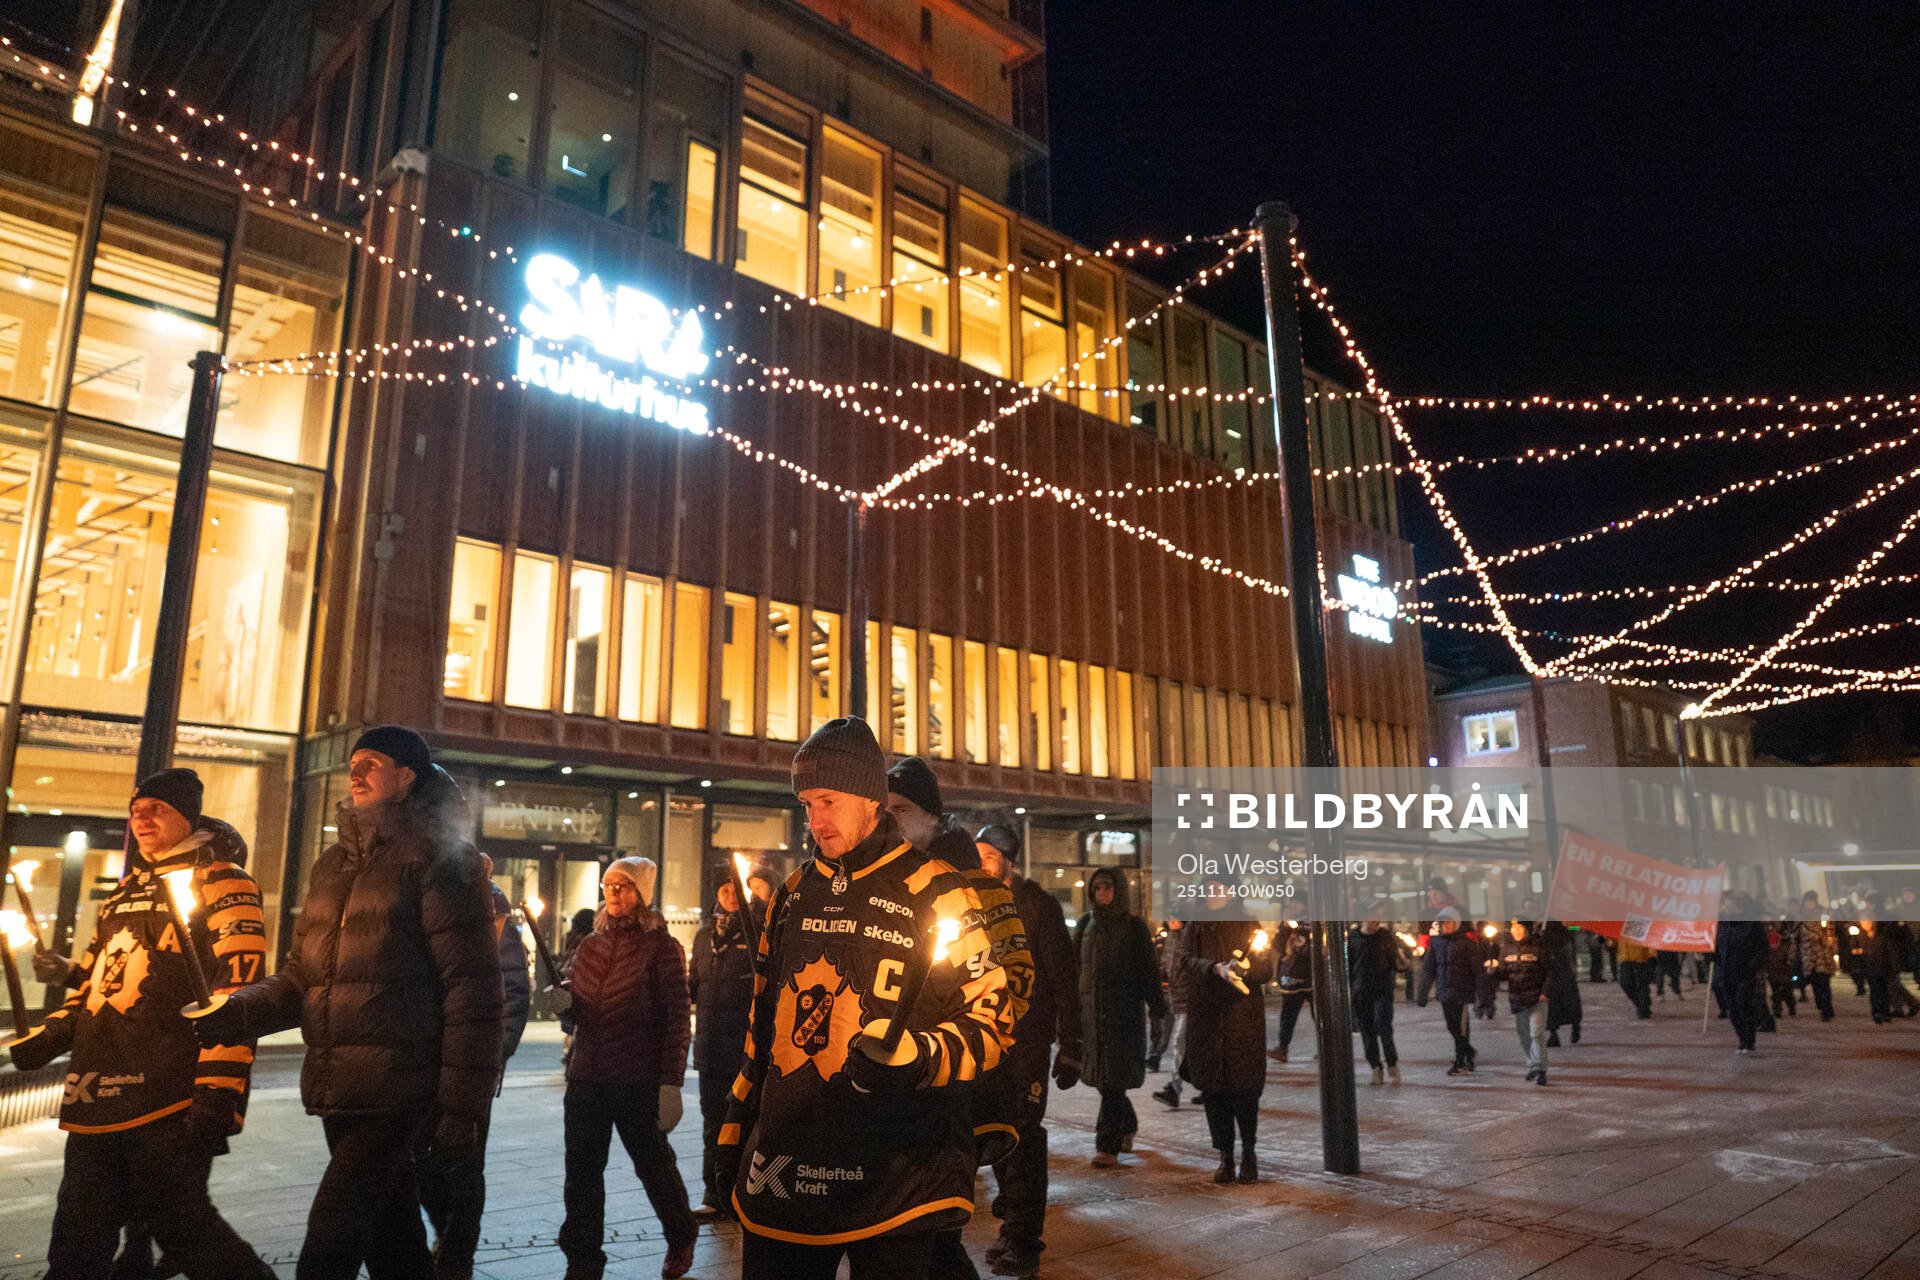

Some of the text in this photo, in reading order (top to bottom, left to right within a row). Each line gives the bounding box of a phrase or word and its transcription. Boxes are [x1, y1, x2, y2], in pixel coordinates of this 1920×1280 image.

[520, 254, 709, 379] SARA
[499, 801, 597, 834] ENTRÉ
[1567, 843, 1596, 867] EN
[1599, 855, 1703, 896] RELATION
[1586, 875, 1702, 919] FRÅN VÅLD
[157, 922, 182, 953] A
[863, 925, 914, 949] skebo
[228, 953, 260, 984] 17
[874, 958, 905, 1001] C
[794, 1180, 829, 1196] Kraft
[797, 1165, 864, 1181] Skellefteå
